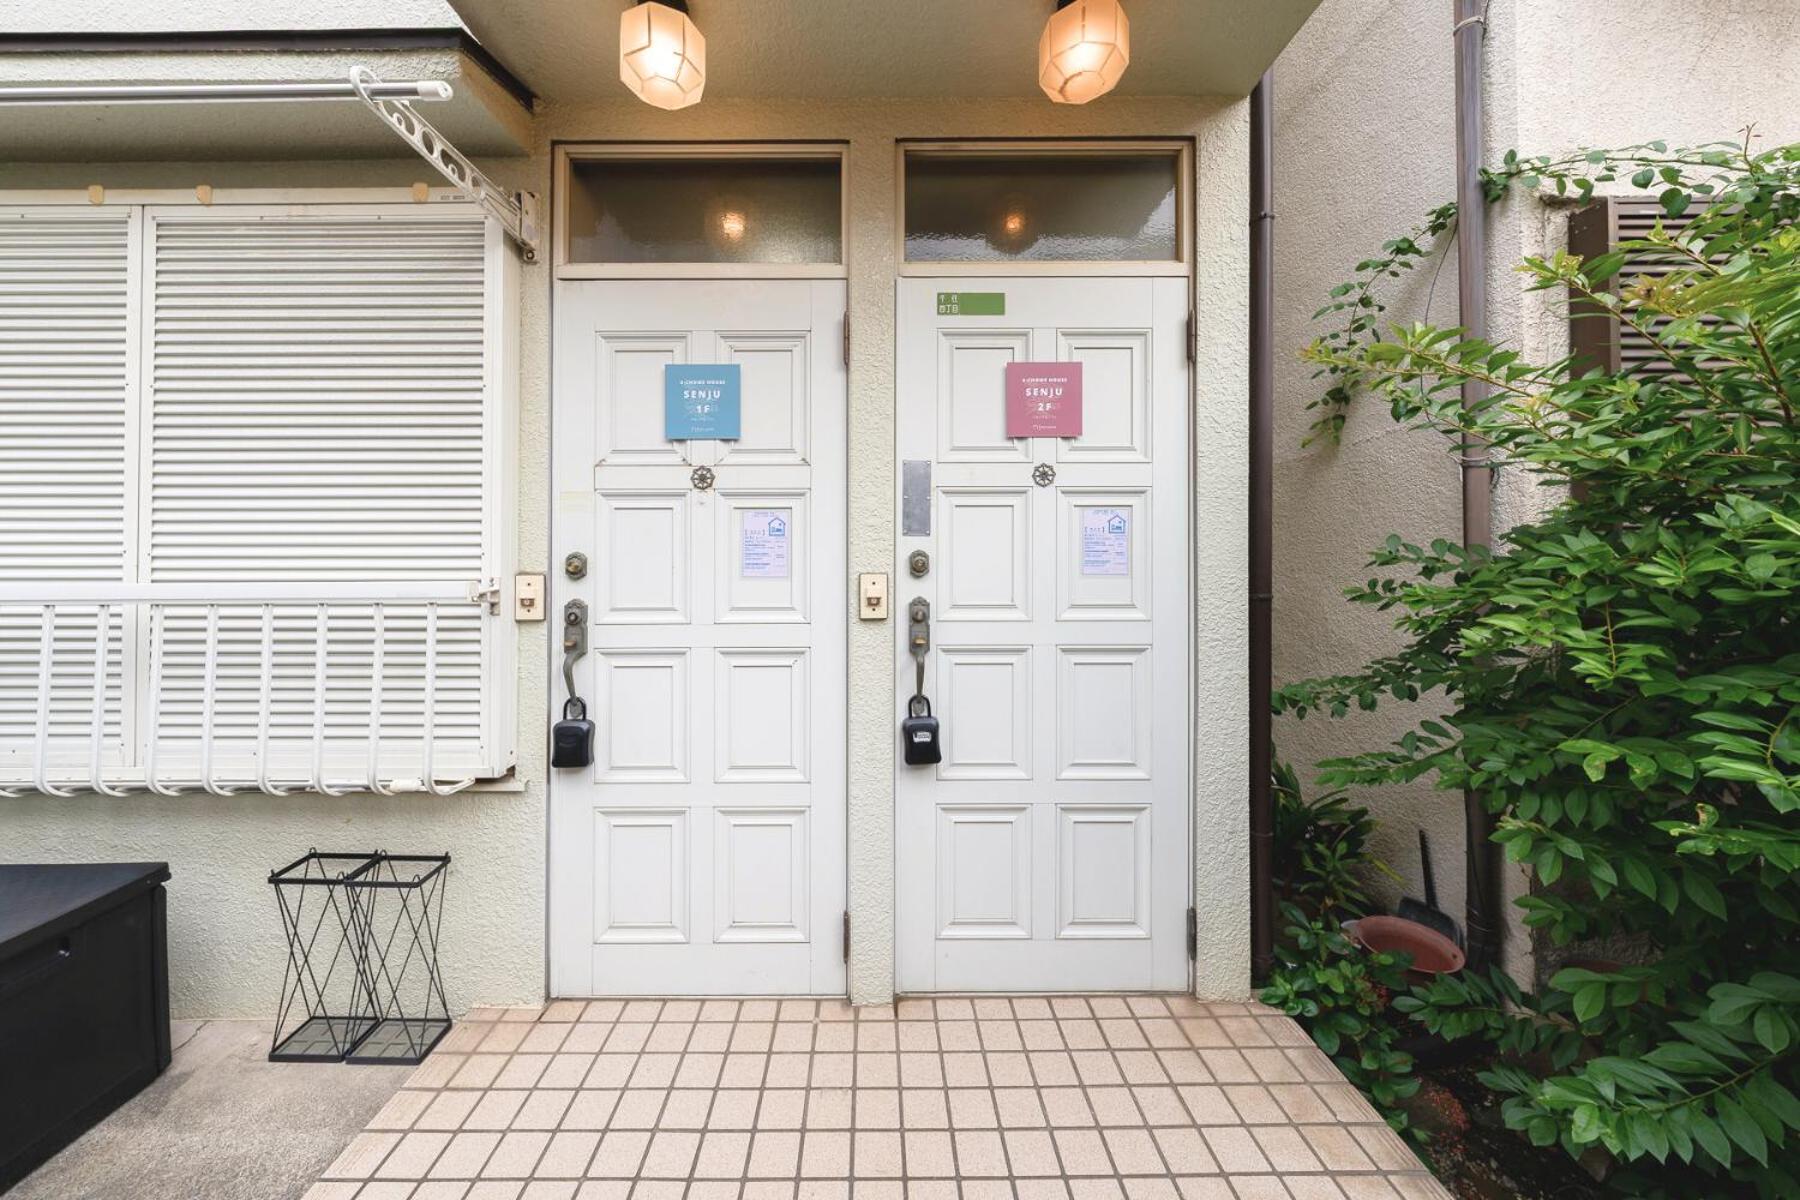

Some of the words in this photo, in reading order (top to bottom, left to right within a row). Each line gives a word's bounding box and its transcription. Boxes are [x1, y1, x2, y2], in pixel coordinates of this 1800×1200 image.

[683, 389, 721, 401] SENJU
[1025, 387, 1063, 398] SENJU
[696, 404, 711, 414] 1F
[1037, 402, 1052, 412] 2F
